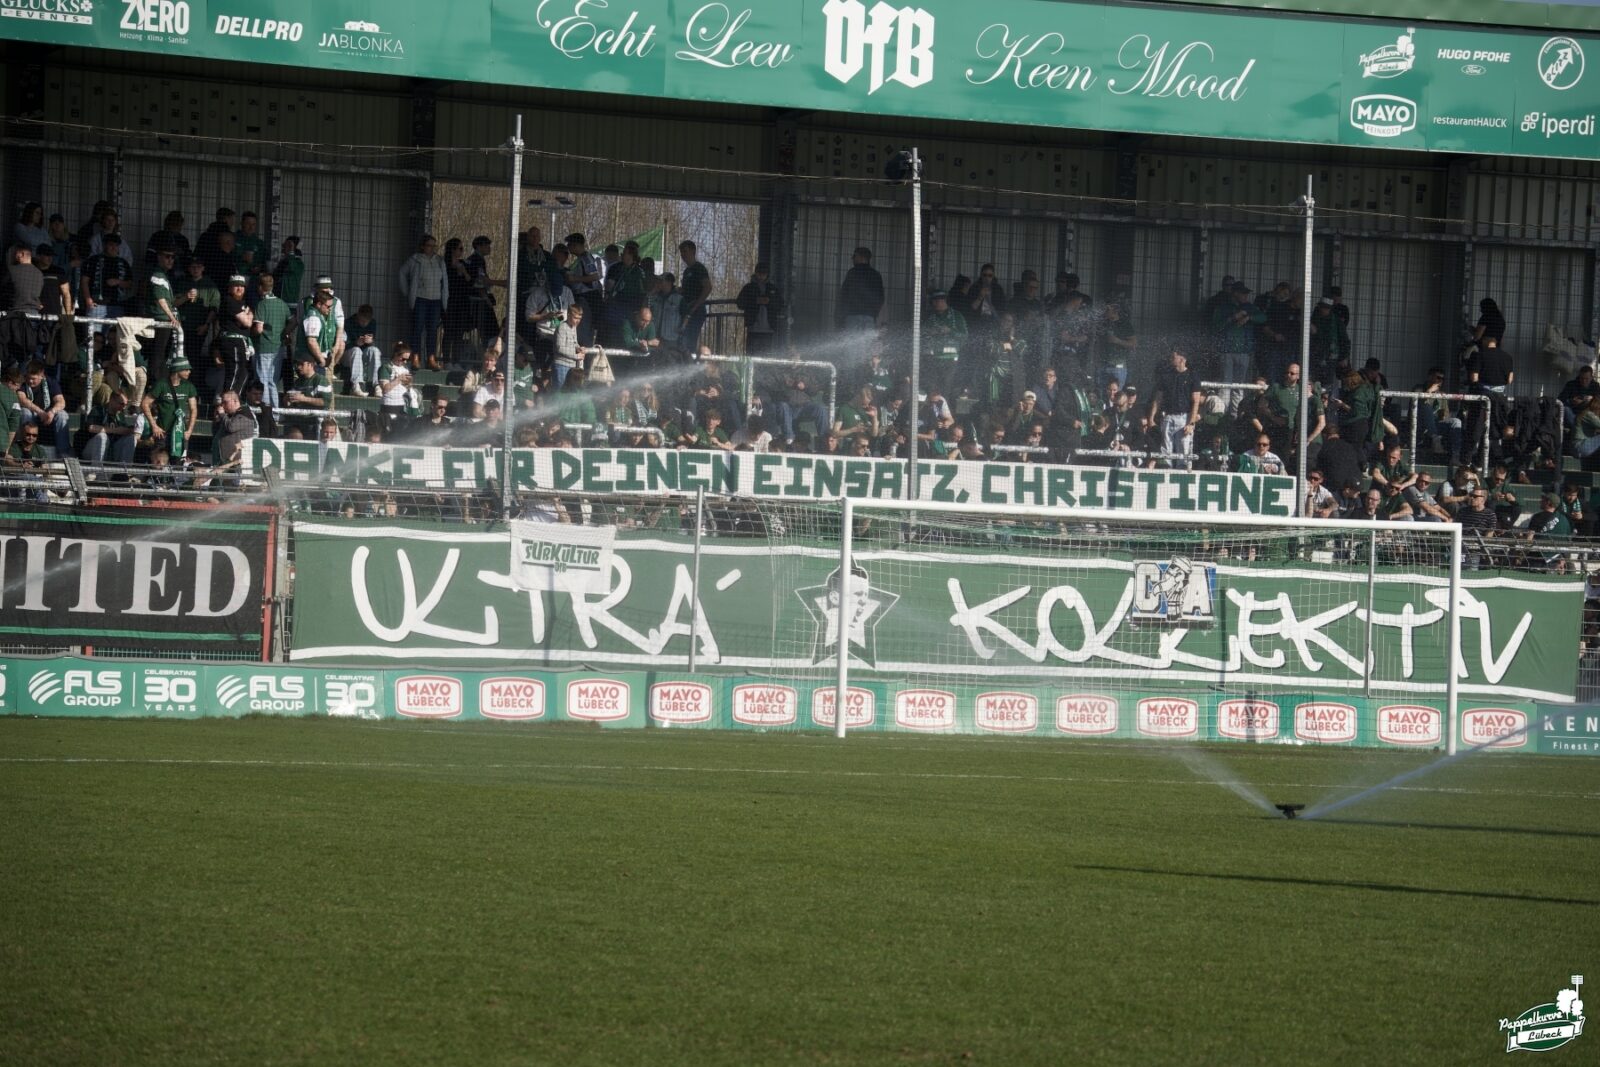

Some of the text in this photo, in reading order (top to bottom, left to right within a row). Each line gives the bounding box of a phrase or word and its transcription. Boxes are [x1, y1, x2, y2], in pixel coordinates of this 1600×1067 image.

[15, 10, 79, 23] EVENTS
[214, 14, 304, 42] DELLPRO
[318, 32, 405, 54] JABLONKA
[536, 0, 656, 59] Echt
[674, 2, 795, 68] Leev
[965, 23, 1098, 91] Keen
[1107, 34, 1257, 102] Mood
[1437, 48, 1511, 63] HUGO PFOHE
[1357, 104, 1410, 123] MAYO
[1433, 115, 1508, 129] restaurantHAUCK
[1541, 112, 1595, 139] iperdi
[1366, 126, 1400, 135] FEINKOST
[251, 438, 1293, 517] DANKE FÜR DEINEN EINSATZ, CHRISTIANE
[64, 670, 122, 695] FLS
[250, 675, 305, 699] FLS
[407, 682, 451, 696] MAYO
[144, 677, 197, 703] 30
[325, 682, 376, 707] 30
[491, 684, 535, 697] MAYO
[578, 685, 620, 699] MAYO
[659, 688, 702, 701] MAYO
[743, 690, 787, 703] MAYO
[63, 695, 122, 707] GROUP
[250, 700, 305, 711] GROUP
[407, 696, 450, 706] LÜBECK
[491, 697, 533, 709] LÜBECK
[578, 699, 619, 710] LÜBECK
[822, 693, 865, 706] MYO
[906, 696, 946, 708] MAYO
[986, 698, 1027, 710] MAYO
[144, 704, 197, 712] YEARS
[659, 702, 701, 712] LÜBECK
[743, 703, 786, 714] LÜBECK
[906, 708, 945, 719] LÜBECK
[1067, 701, 1108, 714] MAYO
[1147, 703, 1188, 716] MAYO
[1229, 706, 1269, 719] MAYO
[986, 710, 1027, 721] LÜBECK
[1067, 714, 1107, 724] LÜBECK
[1147, 716, 1187, 726] LÜBECK
[1305, 708, 1347, 721] MAYO
[1388, 711, 1431, 724] MAYO
[1472, 715, 1516, 727] MAYO
[1229, 718, 1268, 729] LÜBECK
[1305, 721, 1346, 732] LÜBECK
[1388, 724, 1430, 734] LÜBECK
[1544, 715, 1599, 732] KEN
[1472, 727, 1516, 737] LÜBECK
[1553, 741, 1587, 750] Finest
